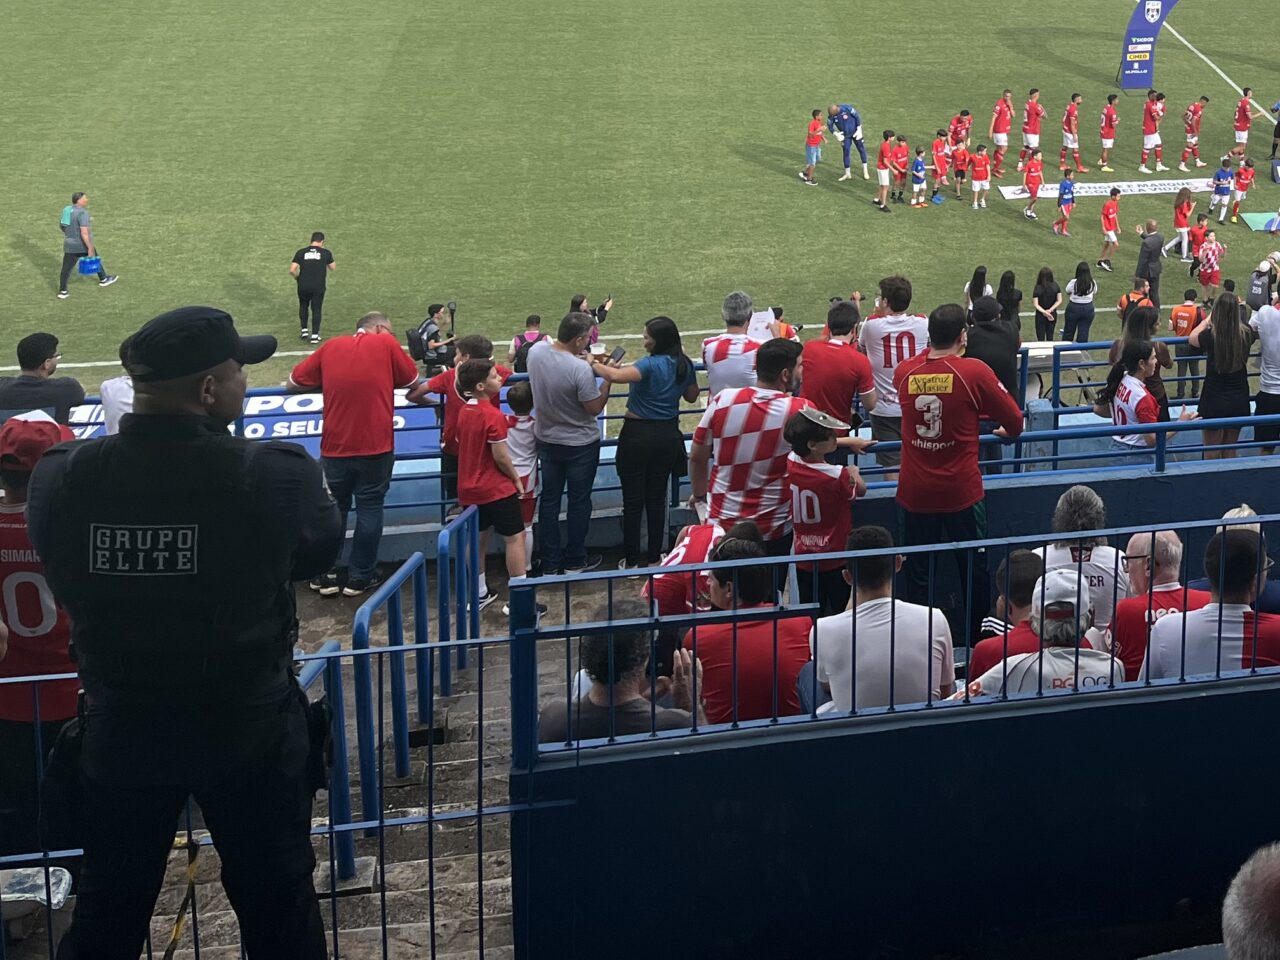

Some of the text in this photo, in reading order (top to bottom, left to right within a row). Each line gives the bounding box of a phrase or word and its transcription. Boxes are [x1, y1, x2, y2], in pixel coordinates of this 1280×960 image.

[881, 331, 916, 368] 10
[915, 382, 950, 393] Master
[914, 395, 943, 439] 3
[911, 439, 956, 452] uhlsport
[791, 483, 821, 524] 10
[96, 529, 192, 549] GRUPO
[95, 551, 192, 570] ELITE
